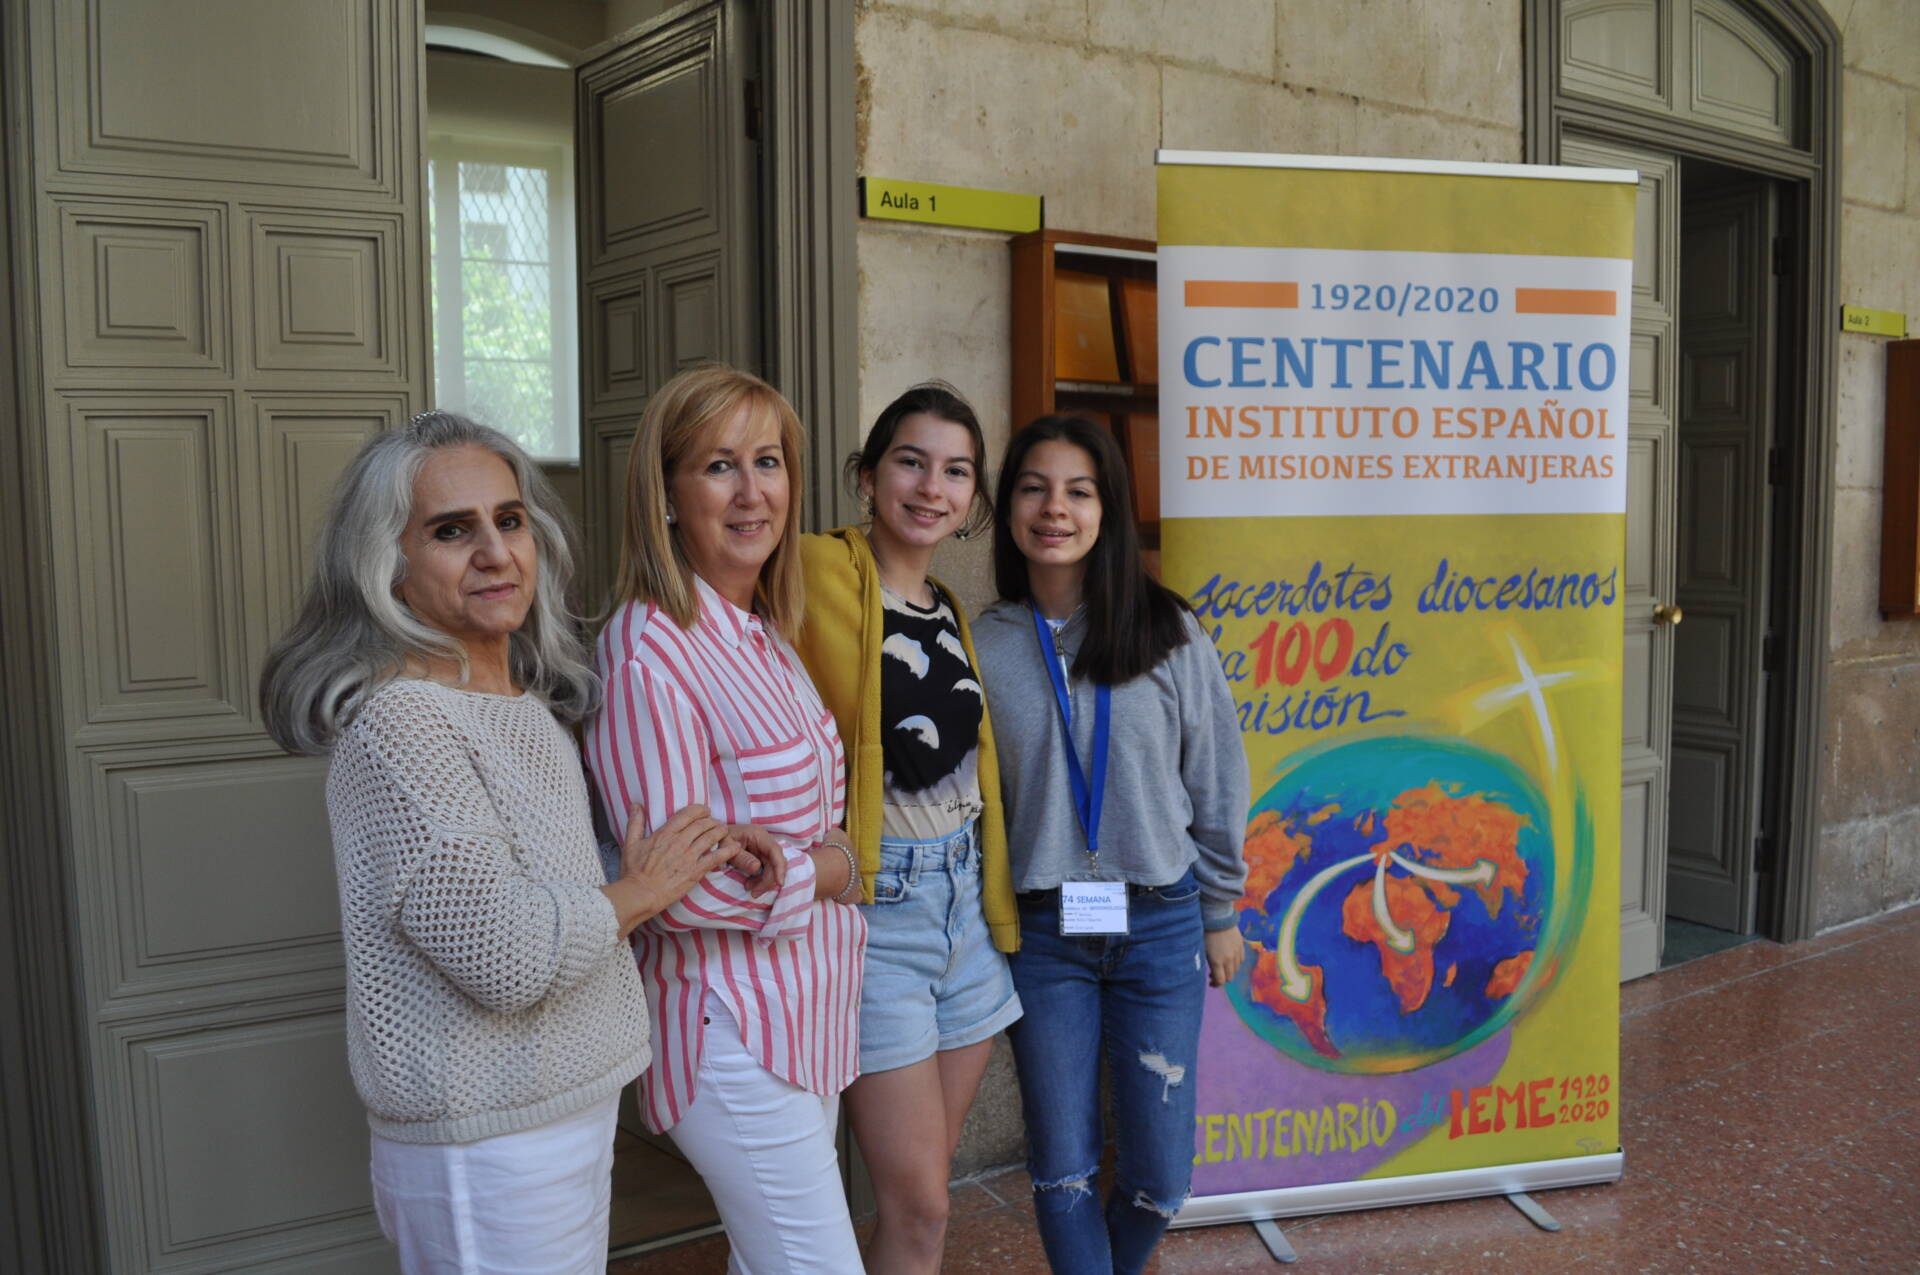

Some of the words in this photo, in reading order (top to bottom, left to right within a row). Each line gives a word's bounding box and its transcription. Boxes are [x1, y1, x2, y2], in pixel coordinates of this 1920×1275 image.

[880, 191, 919, 210] Aula
[928, 195, 936, 212] 1
[1310, 283, 1499, 316] 1920/2020
[1183, 336, 1617, 392] CENTENARIO
[1185, 405, 1419, 439] INSTITUTO
[1432, 400, 1616, 440] ESPAÑOL
[1186, 455, 1229, 480] DE
[1238, 455, 1394, 480] MISIONES
[1402, 455, 1614, 484] EXTRANJERAS
[1190, 560, 1393, 619] sacerdotes
[1417, 558, 1617, 613] diocesanos
[1076, 895, 1112, 904] SEMANA
[1559, 1074, 1611, 1101] 1920
[1447, 1077, 1556, 1141] IEME
[1558, 1099, 1611, 1124] 2020
